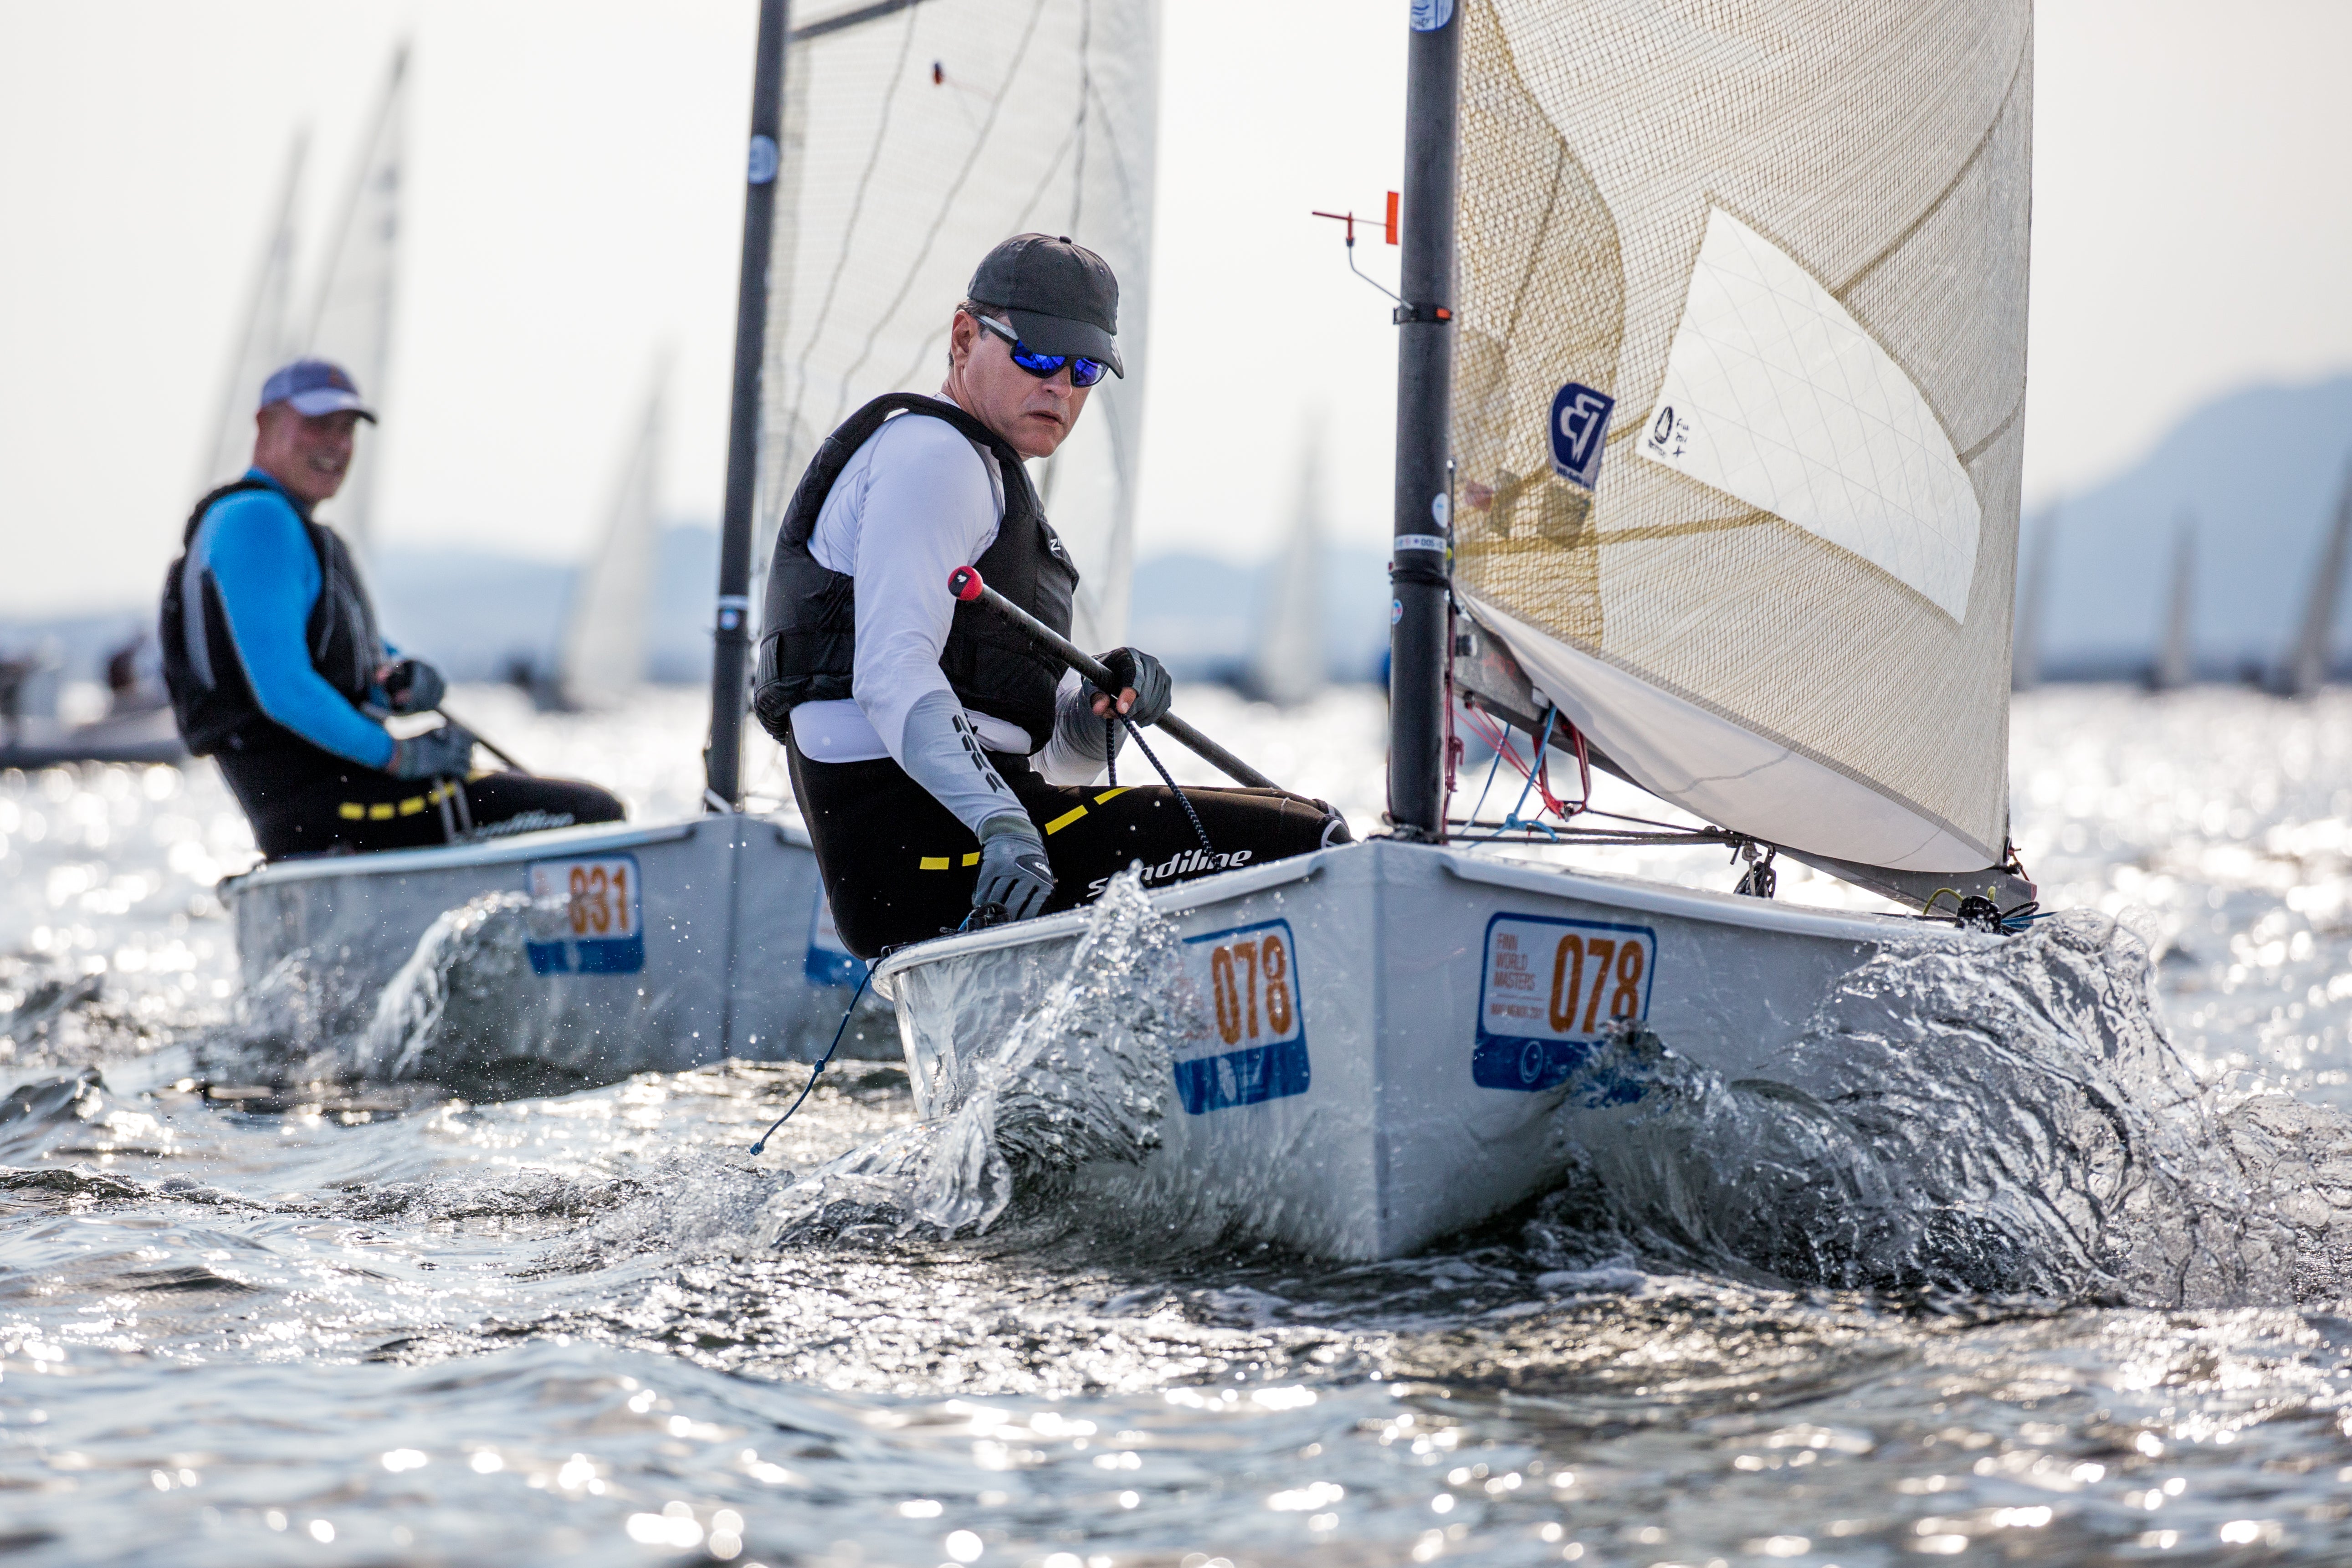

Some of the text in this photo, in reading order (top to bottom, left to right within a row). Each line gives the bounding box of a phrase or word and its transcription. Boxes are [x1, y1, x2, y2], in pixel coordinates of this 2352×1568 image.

[1086, 850, 1252, 897] sndiline
[1212, 935, 1292, 1045] 078
[1550, 933, 1644, 1033] 078
